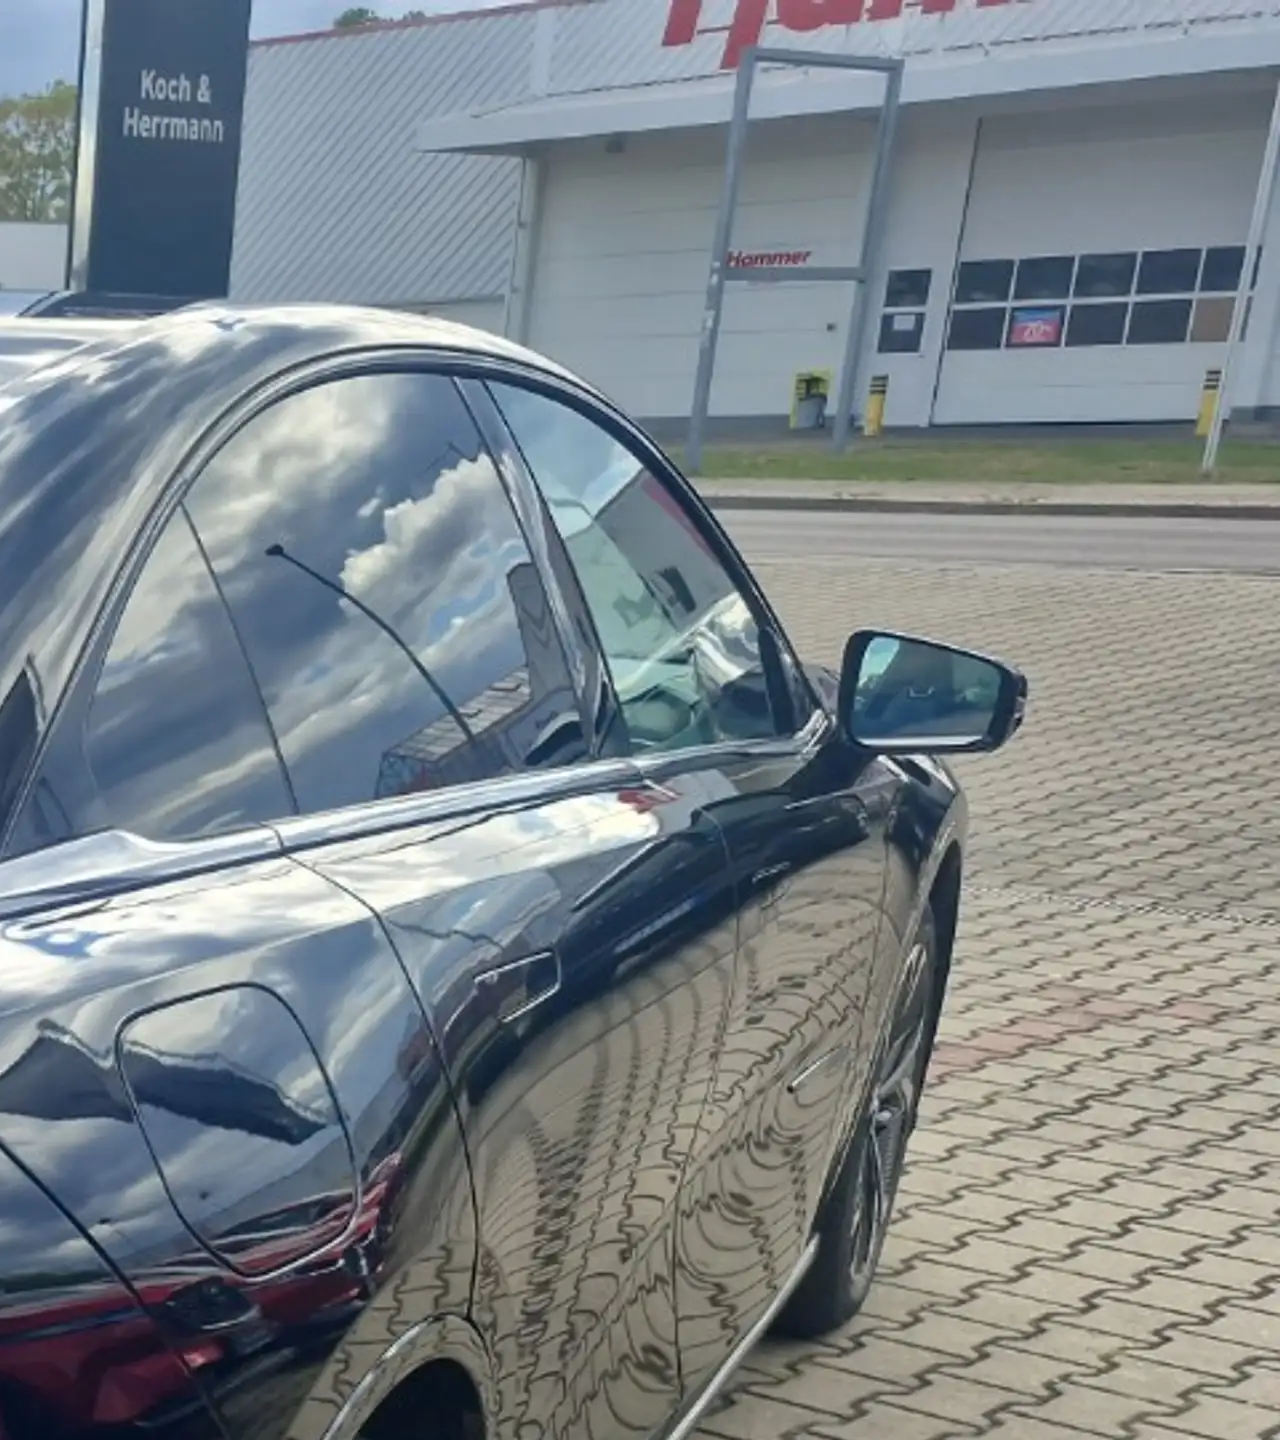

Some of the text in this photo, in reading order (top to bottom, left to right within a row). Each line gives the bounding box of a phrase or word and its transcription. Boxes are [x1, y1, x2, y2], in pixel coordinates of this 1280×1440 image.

[141, 68, 211, 104] Koch &
[123, 106, 223, 142] Herrmann
